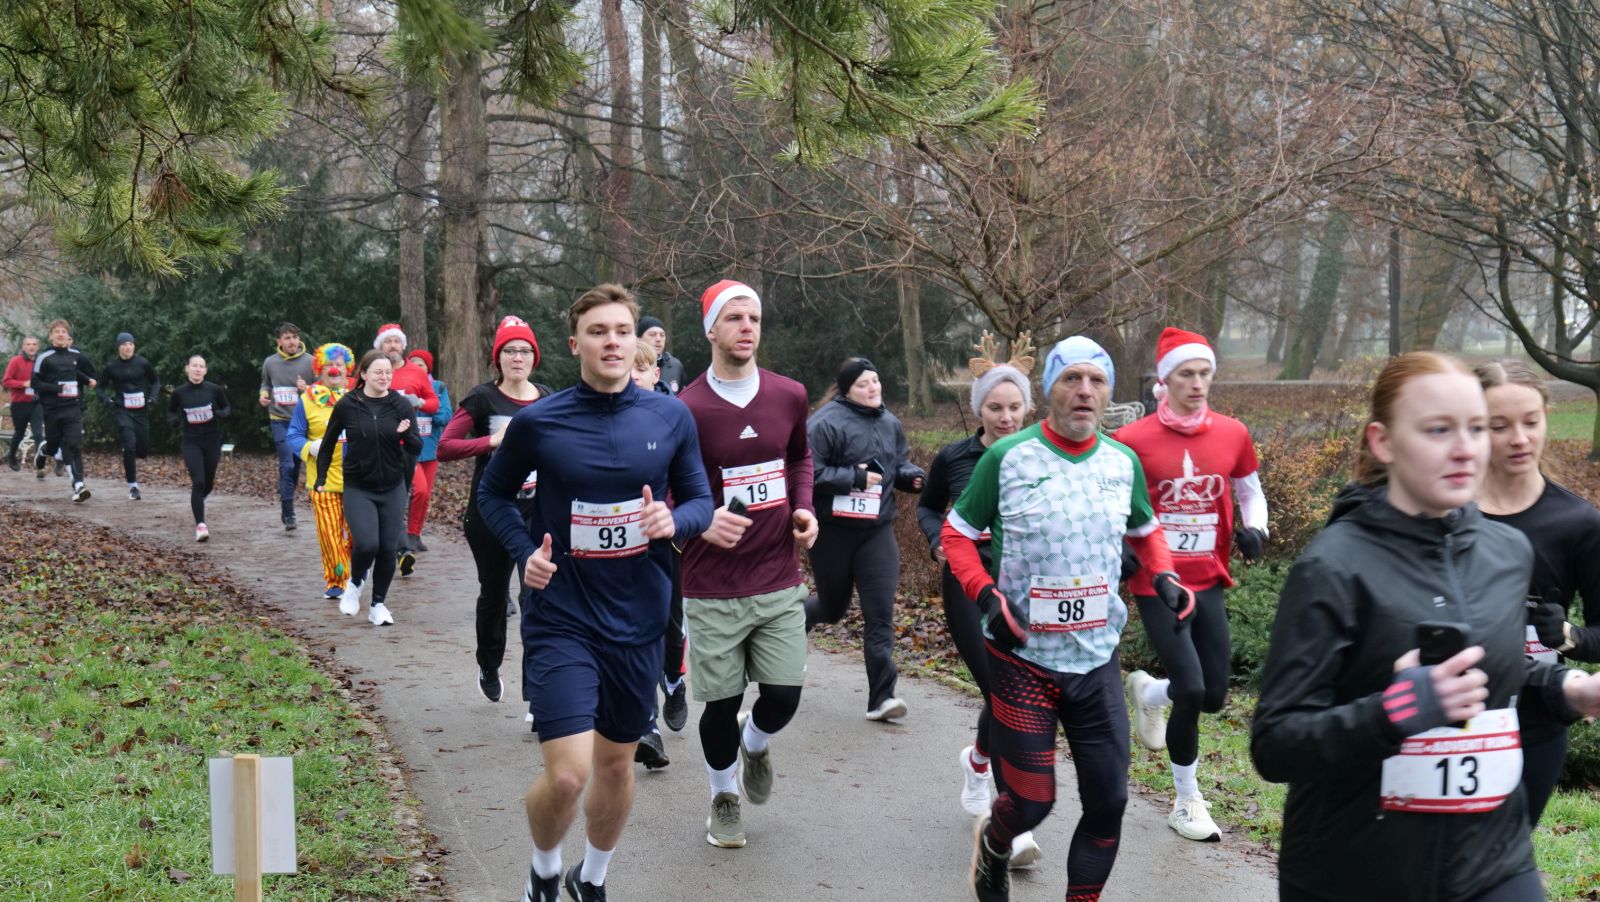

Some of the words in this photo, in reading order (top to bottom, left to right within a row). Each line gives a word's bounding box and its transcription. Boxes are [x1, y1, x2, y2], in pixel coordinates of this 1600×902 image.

[747, 483, 768, 503] 19
[850, 498, 867, 512] 15
[598, 517, 629, 525] ADVENT
[598, 526, 627, 549] 93
[1177, 533, 1200, 550] 27
[1057, 588, 1088, 599] ADVENT
[1088, 585, 1102, 596] RUN
[1058, 599, 1085, 623] 98
[1435, 756, 1478, 796] 13
